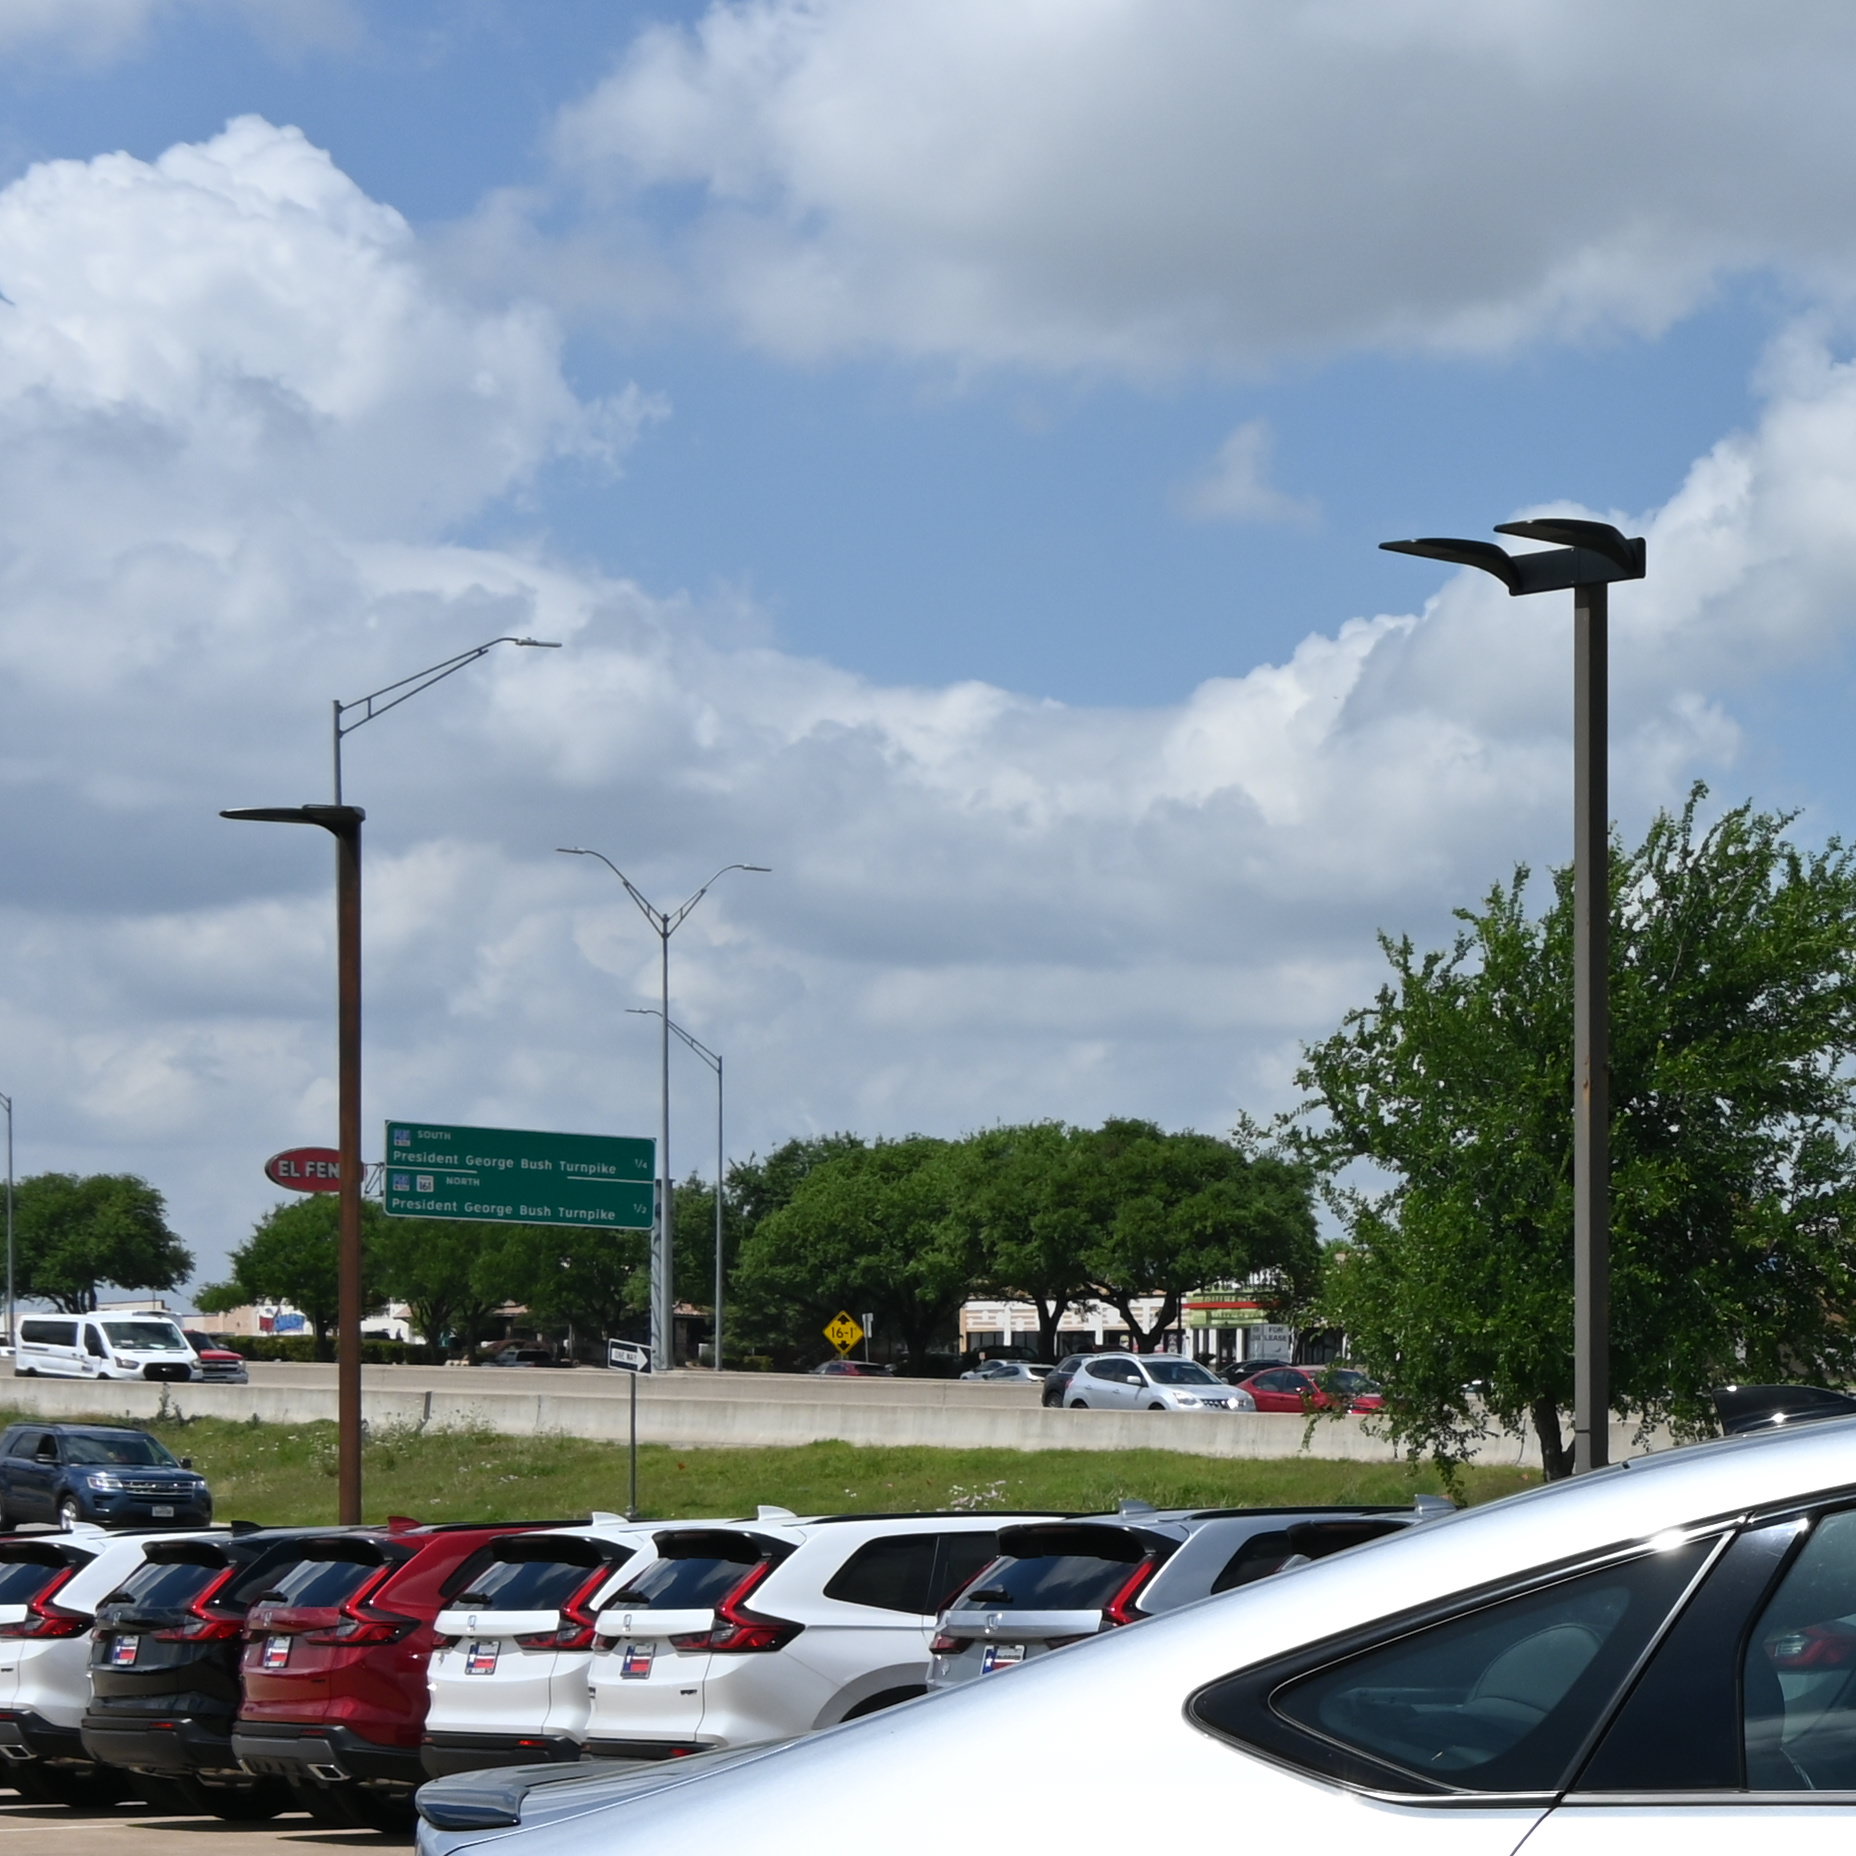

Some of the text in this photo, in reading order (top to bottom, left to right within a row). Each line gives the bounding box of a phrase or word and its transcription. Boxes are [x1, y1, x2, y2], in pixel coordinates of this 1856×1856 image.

[417, 1130, 452, 1140] SOUTH
[278, 1160, 341, 1178] EL FEN
[393, 1150, 459, 1165] President
[465, 1155, 514, 1170] George
[520, 1158, 553, 1171] Bush
[559, 1160, 617, 1175] Turnpike
[446, 1177, 480, 1187] NORTH
[391, 1198, 458, 1212] President
[464, 1202, 513, 1216] George
[519, 1205, 552, 1217] Bush
[558, 1207, 616, 1221] Turnpike
